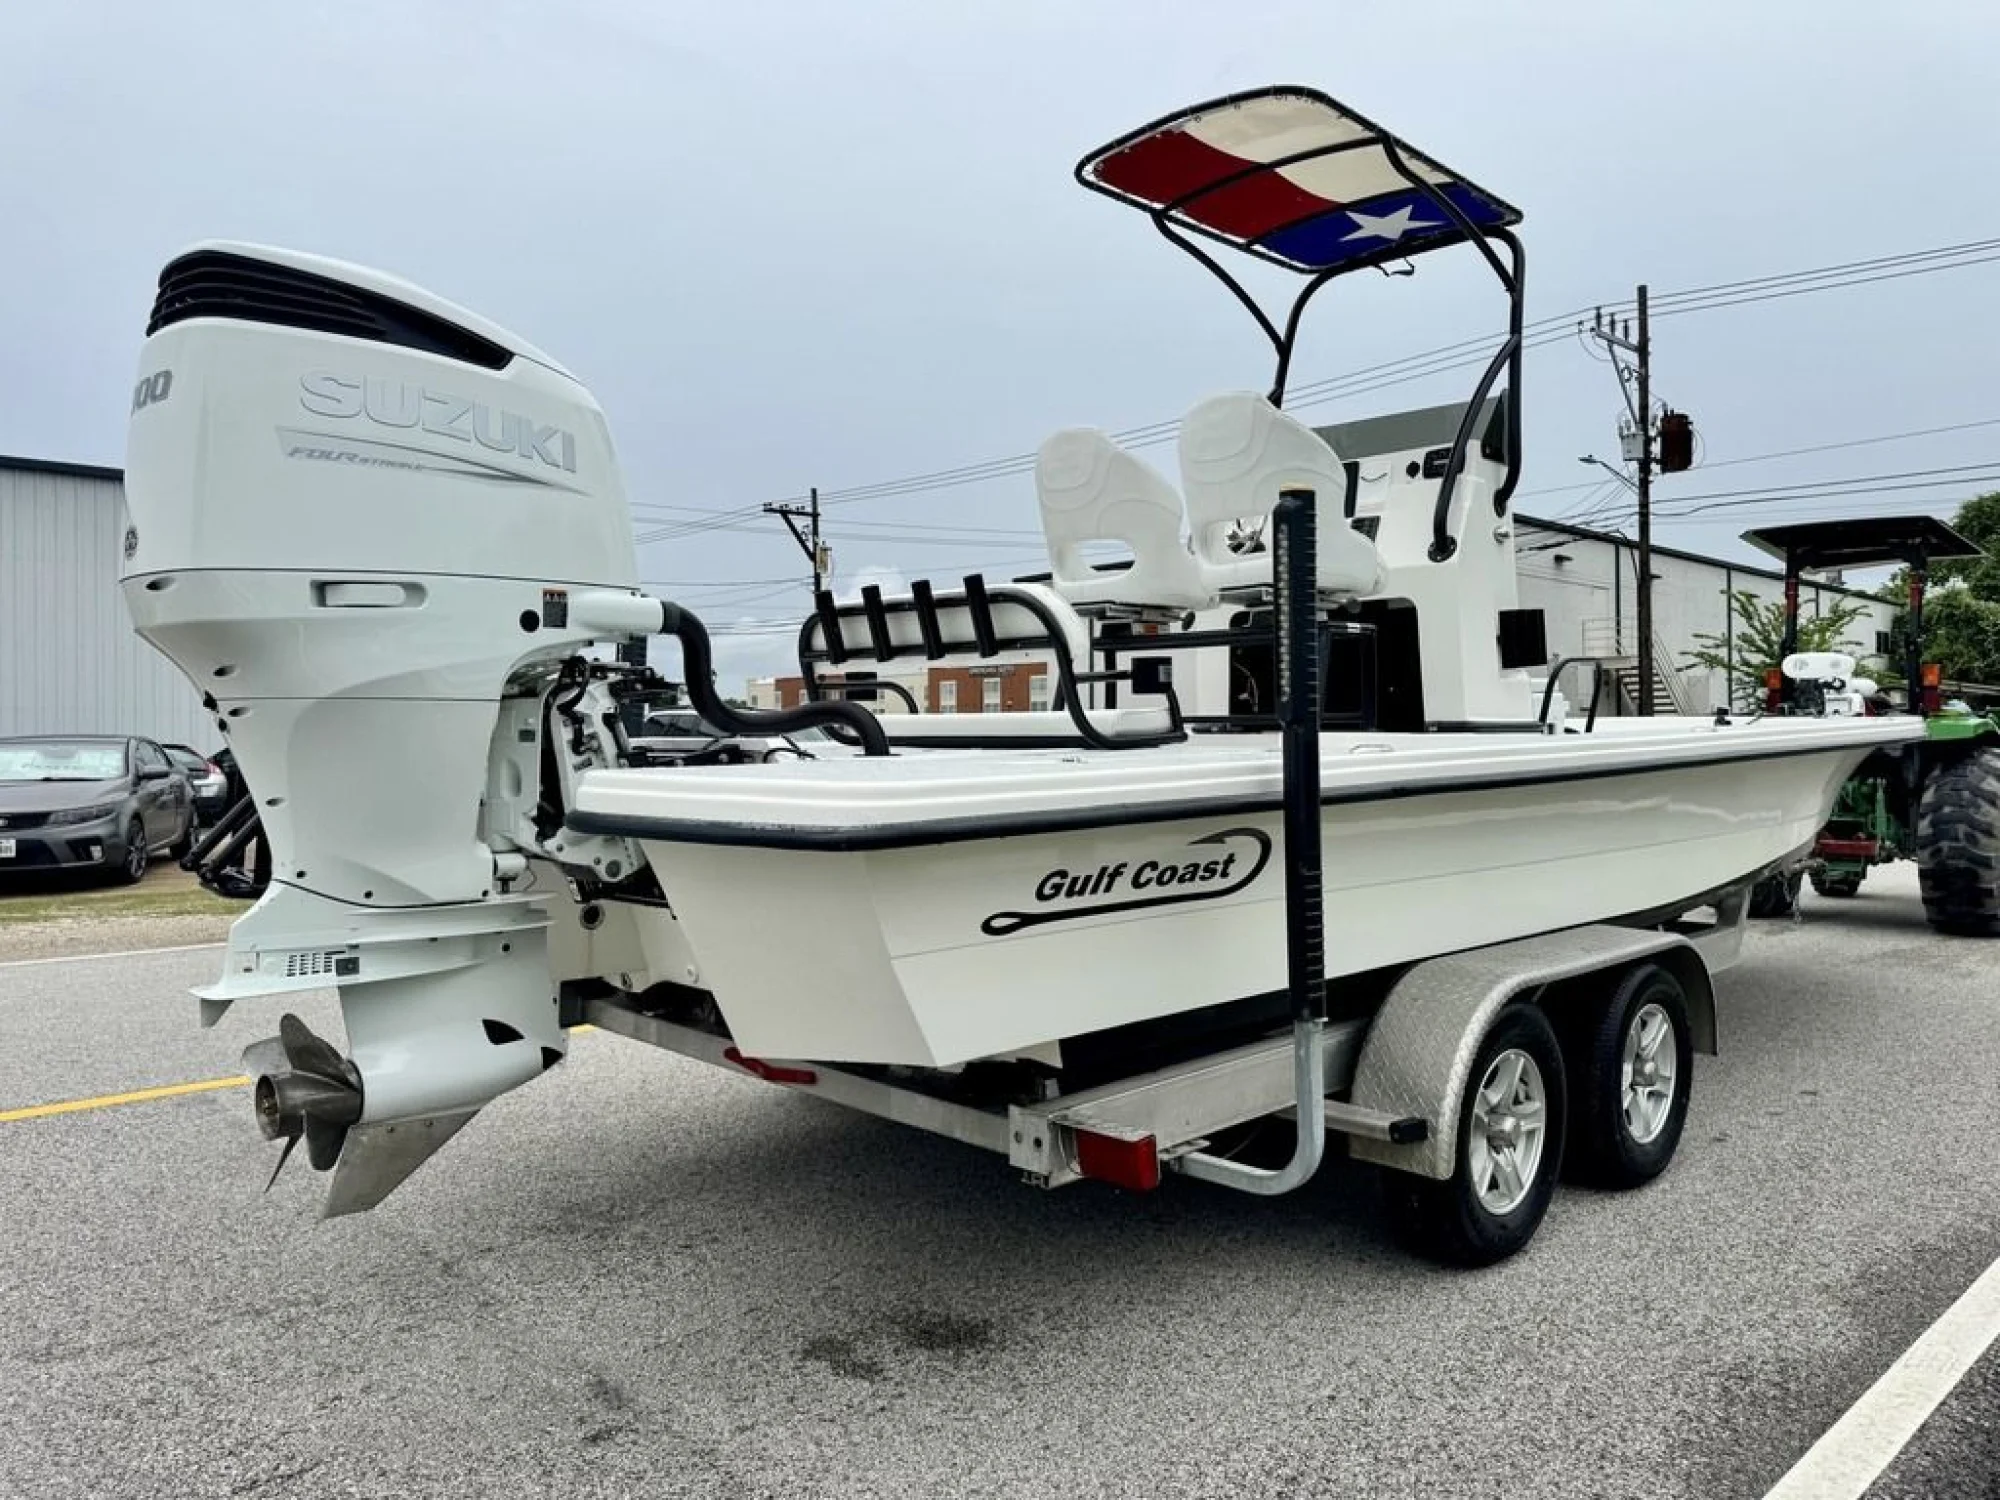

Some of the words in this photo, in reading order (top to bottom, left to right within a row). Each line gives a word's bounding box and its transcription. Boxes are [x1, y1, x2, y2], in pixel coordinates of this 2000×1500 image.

[131, 369, 173, 417] 00
[300, 370, 577, 474] SUZUKI
[1035, 862, 1128, 902] Gulf
[1131, 853, 1236, 890] Coast
